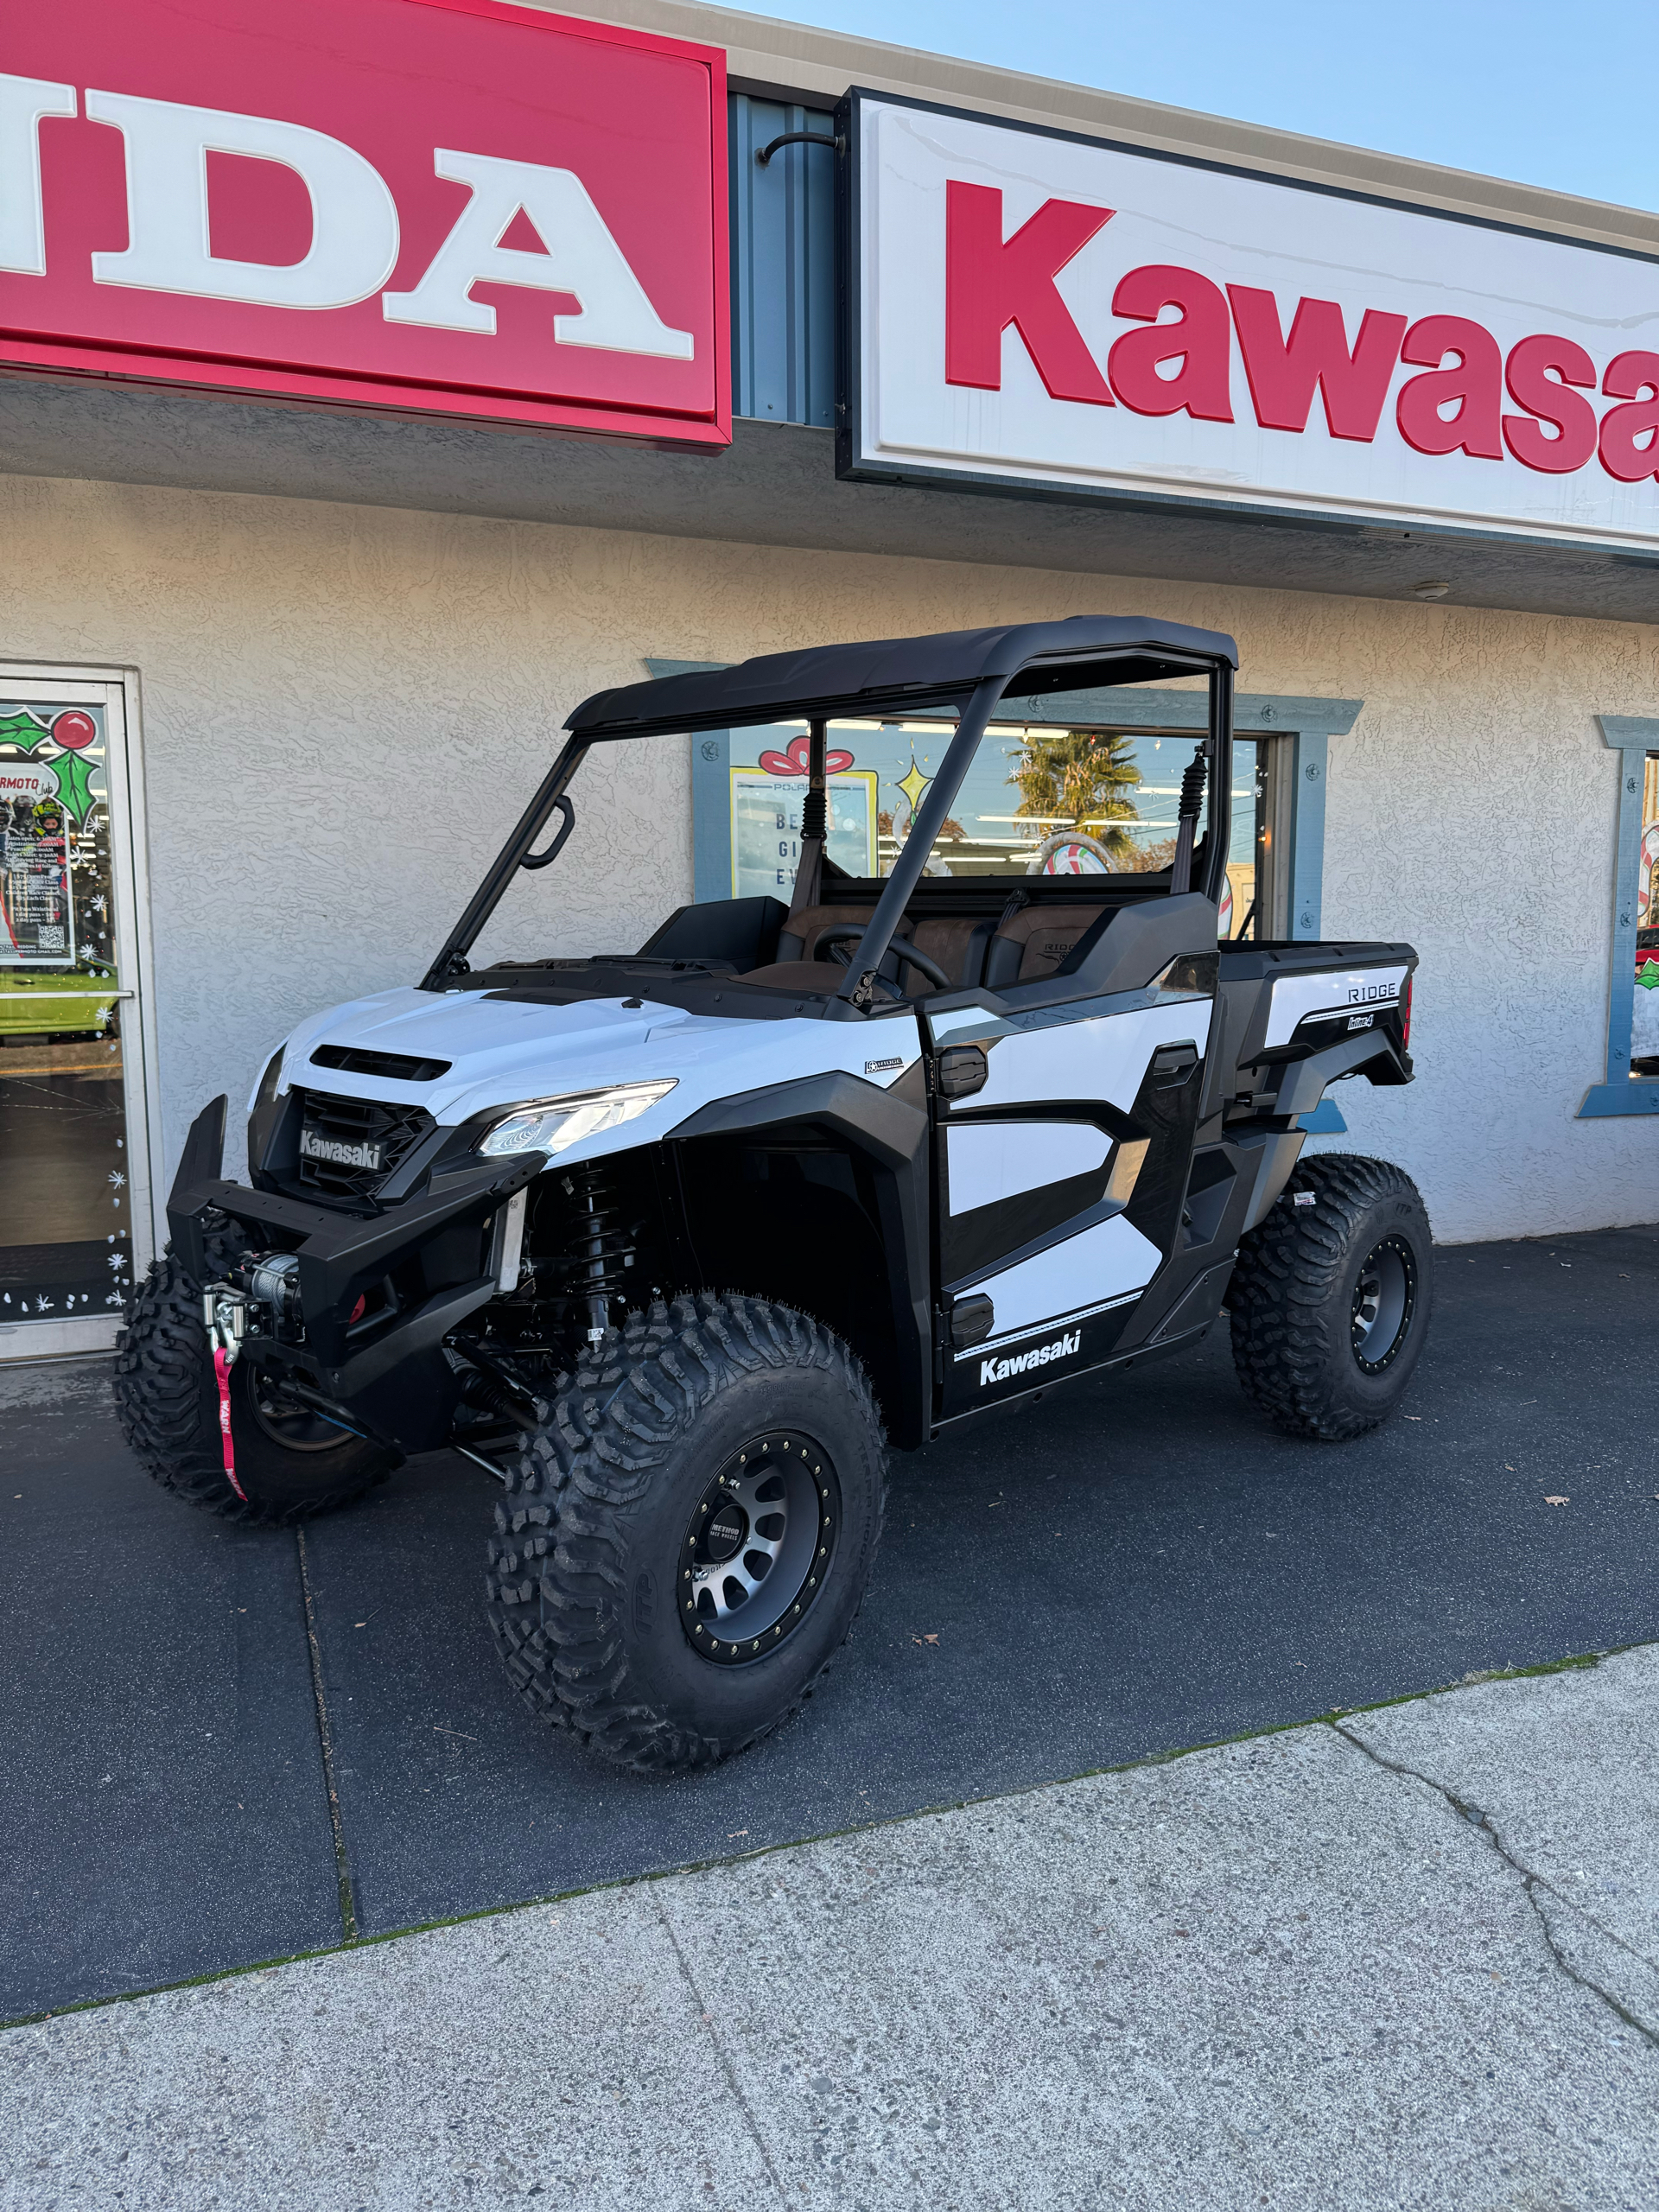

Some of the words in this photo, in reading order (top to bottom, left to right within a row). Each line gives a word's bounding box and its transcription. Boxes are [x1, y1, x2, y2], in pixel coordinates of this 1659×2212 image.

[0, 73, 694, 361] DA
[35, 782, 54, 796] Club
[779, 841, 804, 858] GI
[1348, 982, 1395, 1003] RIDGE
[299, 1129, 380, 1169] Kawasaki
[980, 1329, 1082, 1386] Kawasaki
[221, 1400, 231, 1434] WARN
[711, 1523, 740, 1535] METHOD
[635, 1573, 653, 1636] ITP
